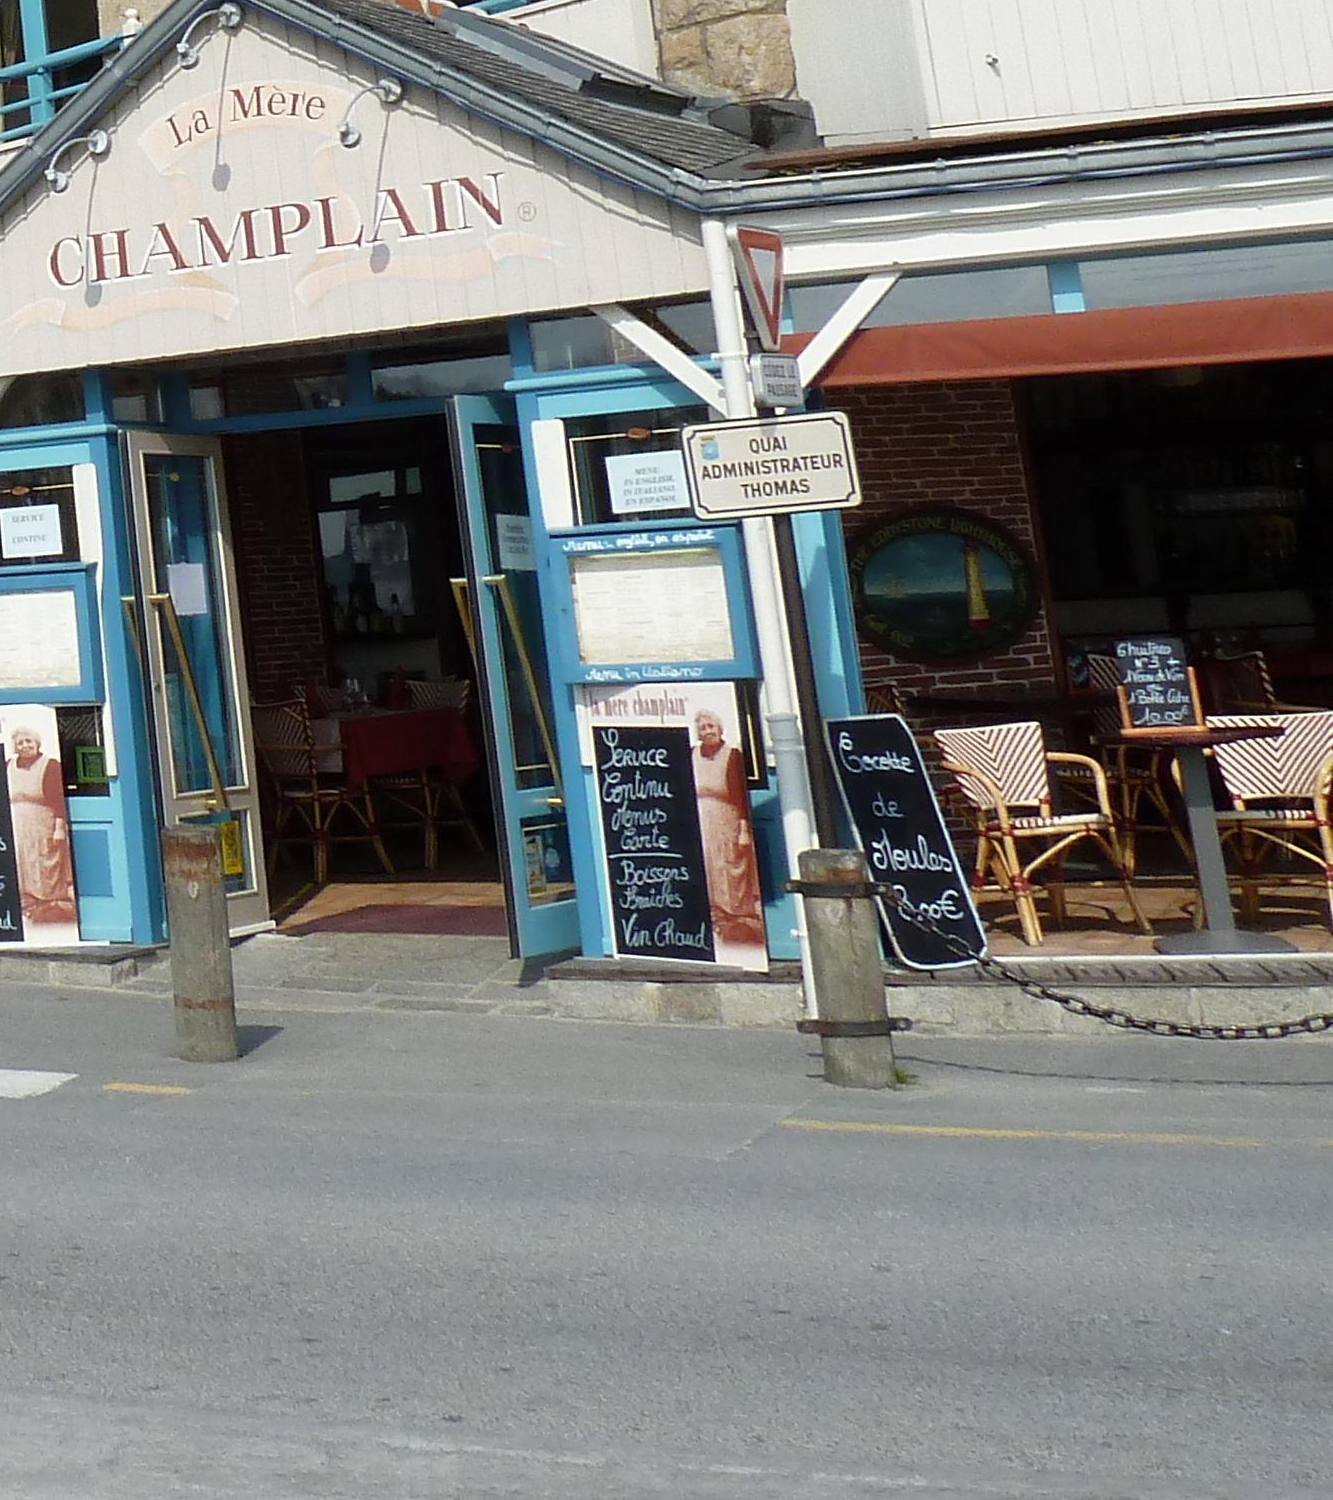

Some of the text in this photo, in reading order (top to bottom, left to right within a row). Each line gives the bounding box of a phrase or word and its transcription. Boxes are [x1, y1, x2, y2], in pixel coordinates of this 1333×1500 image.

[165, 83, 327, 150] La Mère
[47, 171, 506, 288] CHAMPLAIN
[749, 436, 788, 454] QUAI
[701, 453, 844, 480] ADMINISTRATEUR
[740, 479, 810, 499] THOMAS
[633, 688, 687, 724] champlain
[601, 729, 670, 770] Service
[602, 771, 674, 803] Continu
[611, 801, 667, 831] Menus
[872, 792, 904, 818] de
[620, 827, 670, 850] Carte
[870, 828, 953, 872] Moules
[617, 860, 690, 886] Boissons
[621, 913, 652, 947] Vin
